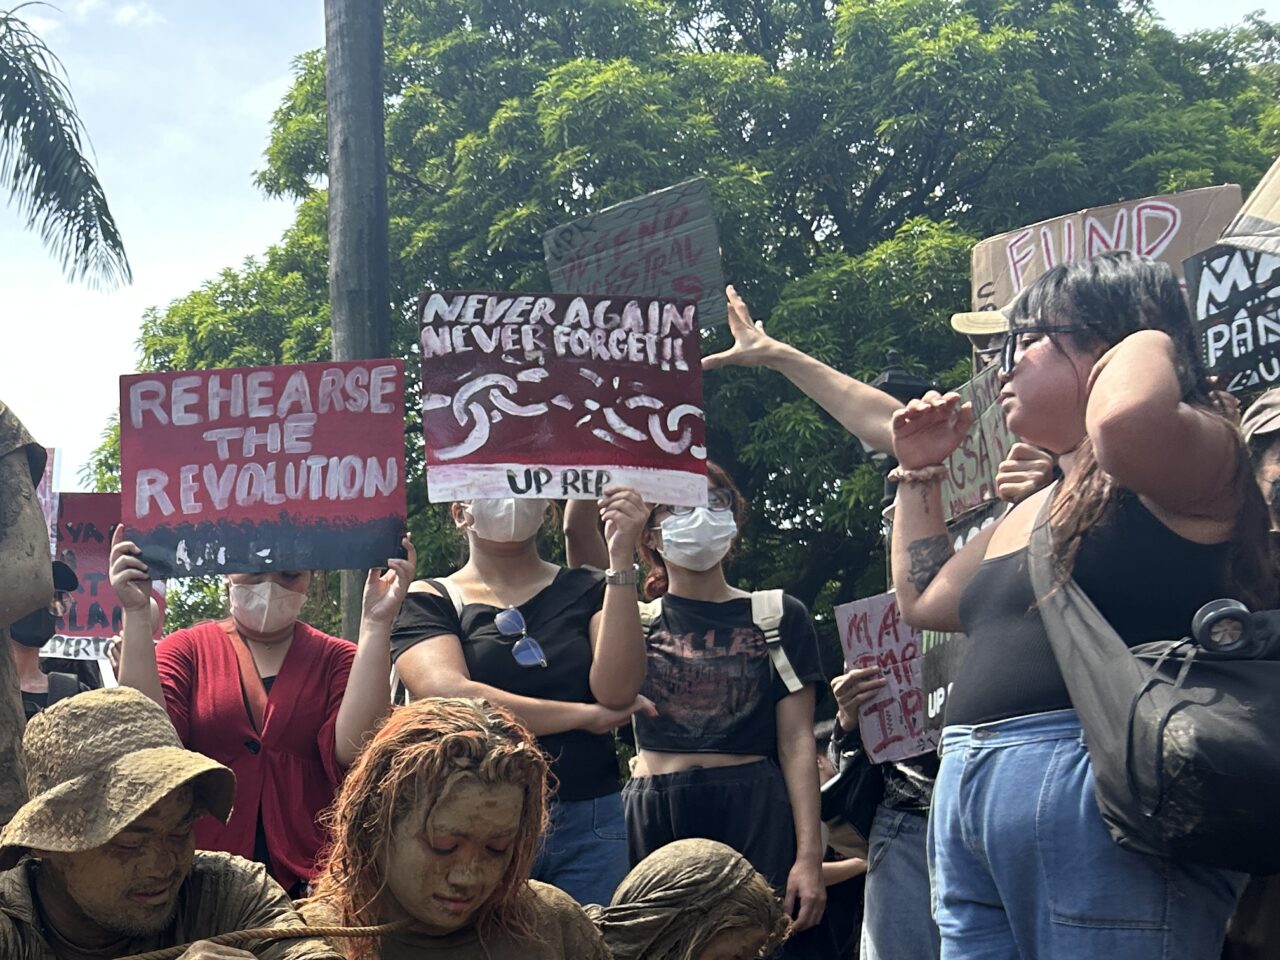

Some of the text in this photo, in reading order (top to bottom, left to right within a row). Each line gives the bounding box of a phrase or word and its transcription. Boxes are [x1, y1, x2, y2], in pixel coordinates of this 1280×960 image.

[422, 293, 696, 338] NEVER AGAIN
[421, 324, 547, 359] NEVER
[130, 364, 398, 429] REHEARSE
[203, 412, 317, 460] THE
[135, 455, 398, 519] REVOLUTION
[506, 469, 612, 498] UP REP
